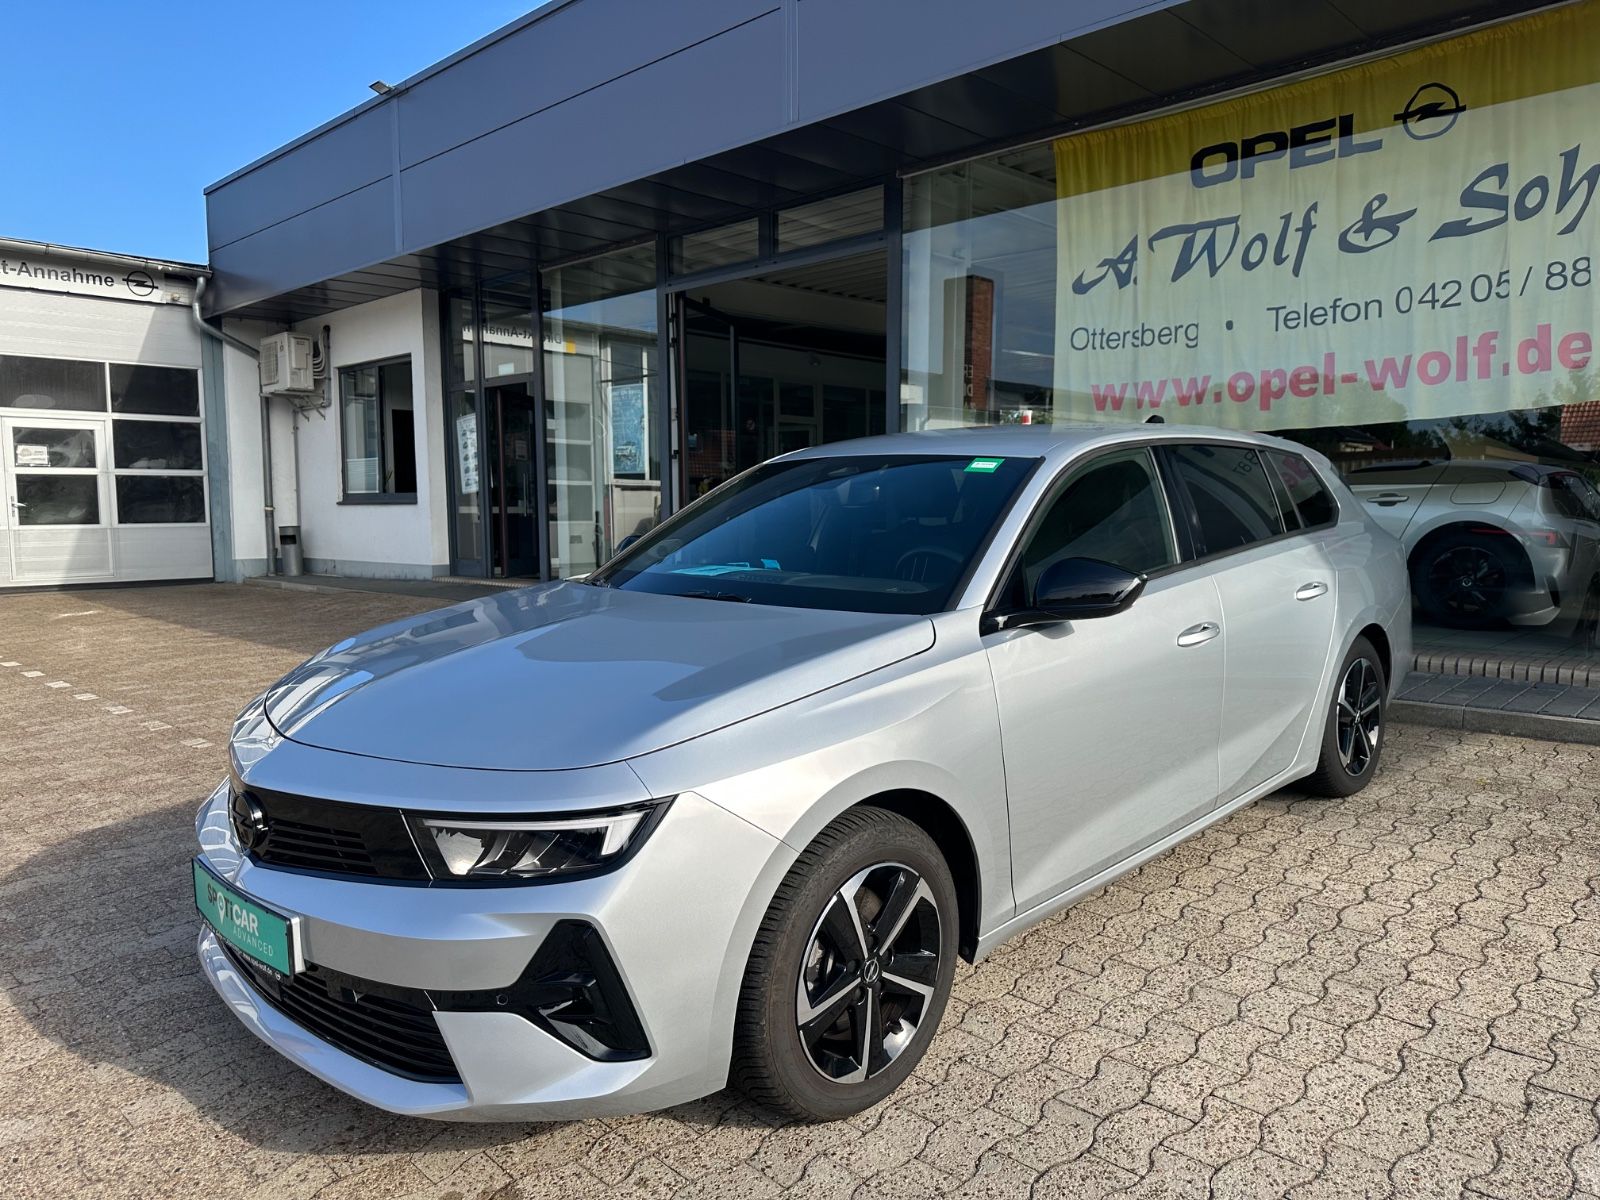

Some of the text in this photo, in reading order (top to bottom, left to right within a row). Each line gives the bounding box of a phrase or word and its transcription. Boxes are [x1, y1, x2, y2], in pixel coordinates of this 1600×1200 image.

[1190, 113, 1384, 189] OPEL
[1147, 200, 1319, 284] Wolf
[1337, 192, 1419, 254] &
[0, 259, 115, 287] t-Annahme
[1069, 320, 1200, 352] Ottersberg
[1266, 297, 1383, 333] Telefon
[1090, 322, 1593, 412] www.opel-wolf.de
[232, 925, 275, 958] ADVANCED
